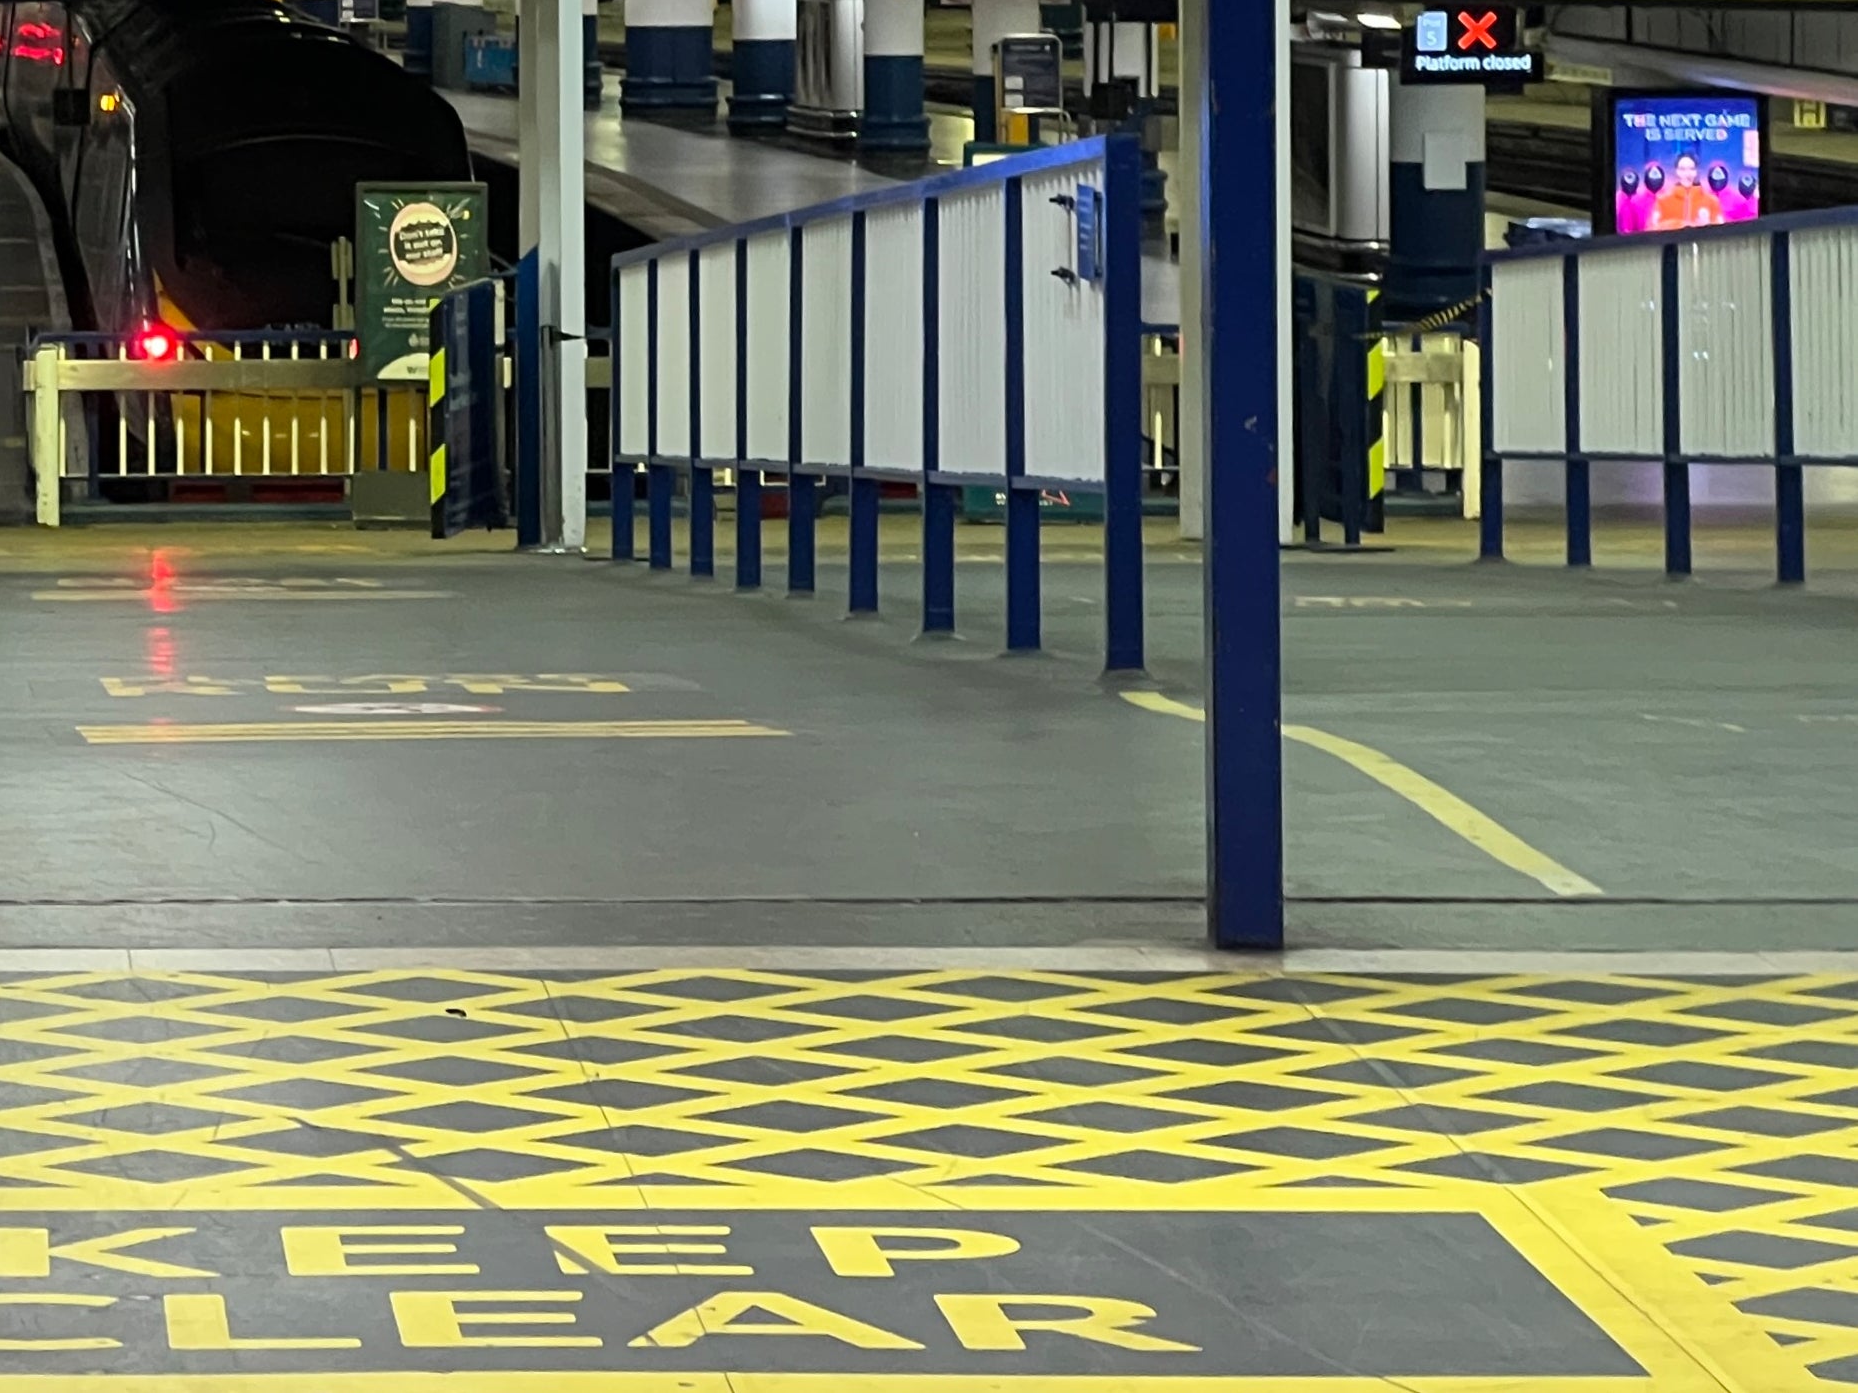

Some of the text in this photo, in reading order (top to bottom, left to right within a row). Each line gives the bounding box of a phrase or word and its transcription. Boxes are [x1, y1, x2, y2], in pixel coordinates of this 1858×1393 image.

[1415, 53, 1533, 72] Platform closed
[1623, 112, 1751, 128] THE NEXT GAME
[1663, 127, 1728, 142] SERVED
